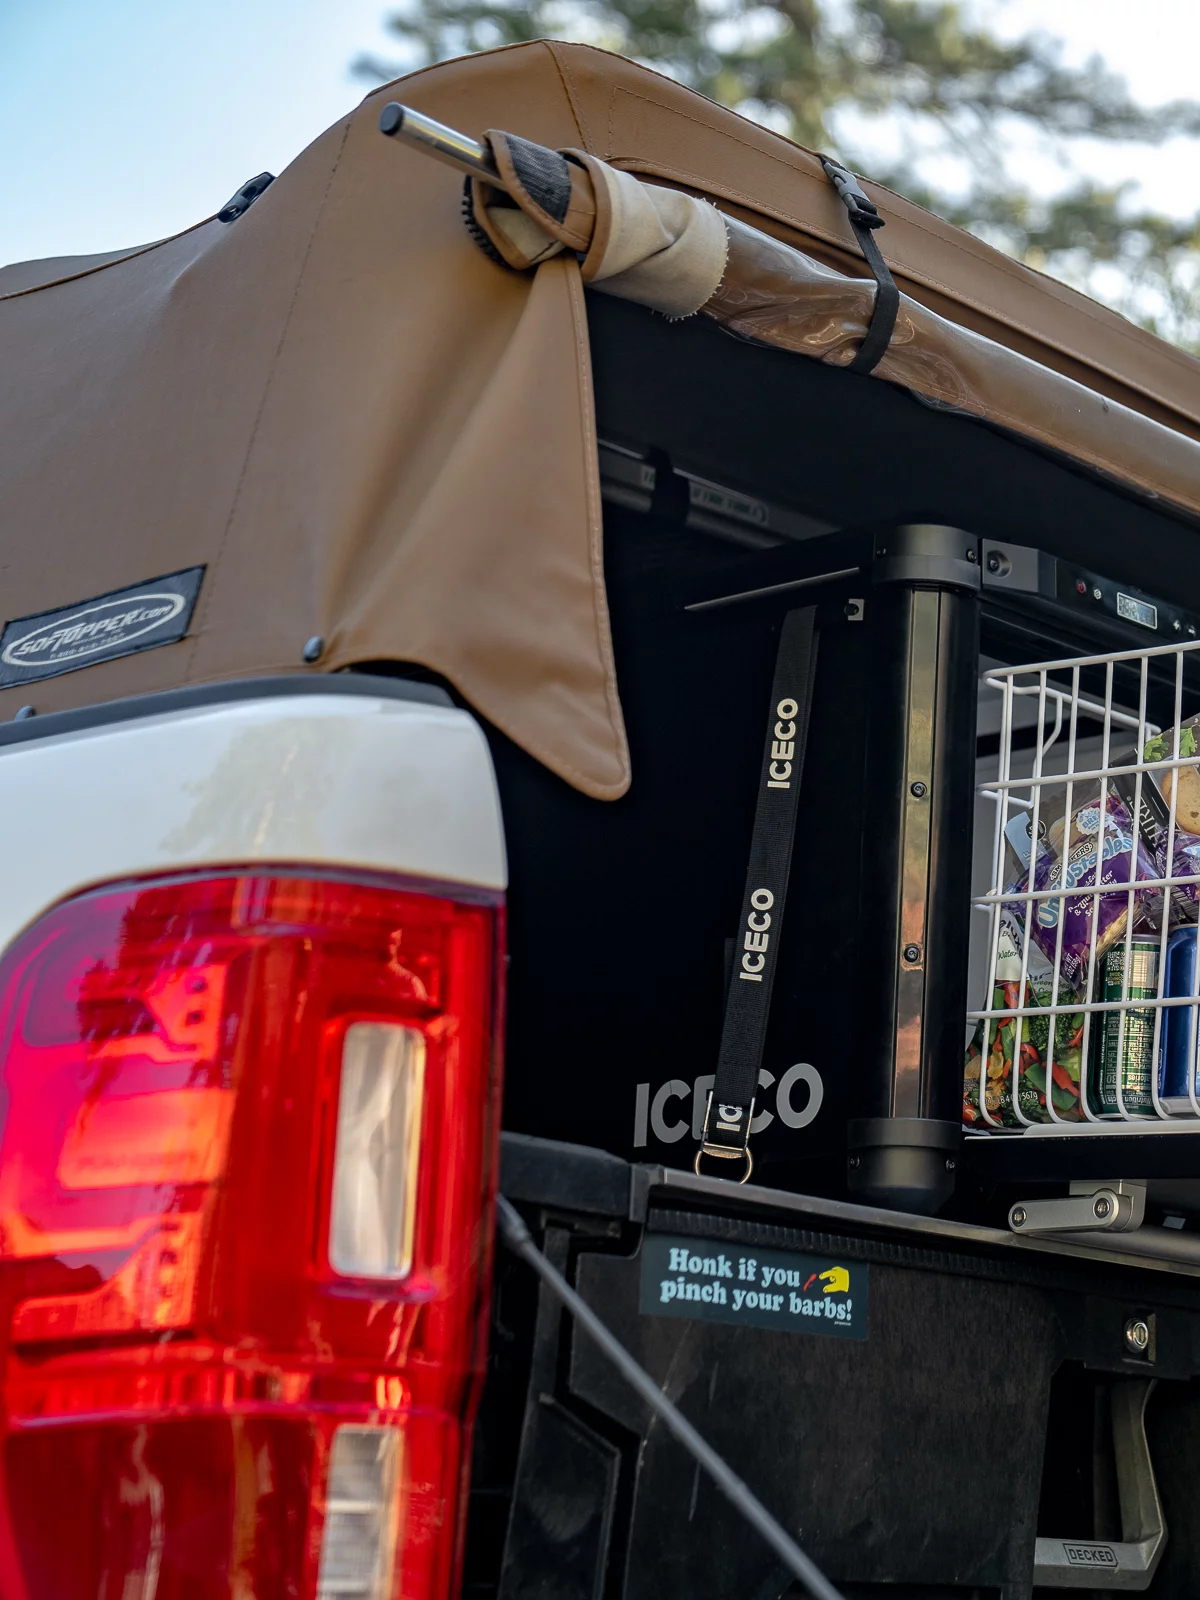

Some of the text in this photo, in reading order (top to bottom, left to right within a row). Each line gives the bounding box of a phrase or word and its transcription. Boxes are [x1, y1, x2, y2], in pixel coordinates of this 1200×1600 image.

[767, 698, 799, 789] ICECO
[1050, 842, 1093, 881] SMKER'S
[739, 888, 775, 982] ICECO
[668, 1248, 800, 1288] Honk if you
[660, 1277, 853, 1321] pinch your barbs!
[1068, 1548, 1114, 1562] DECKED
